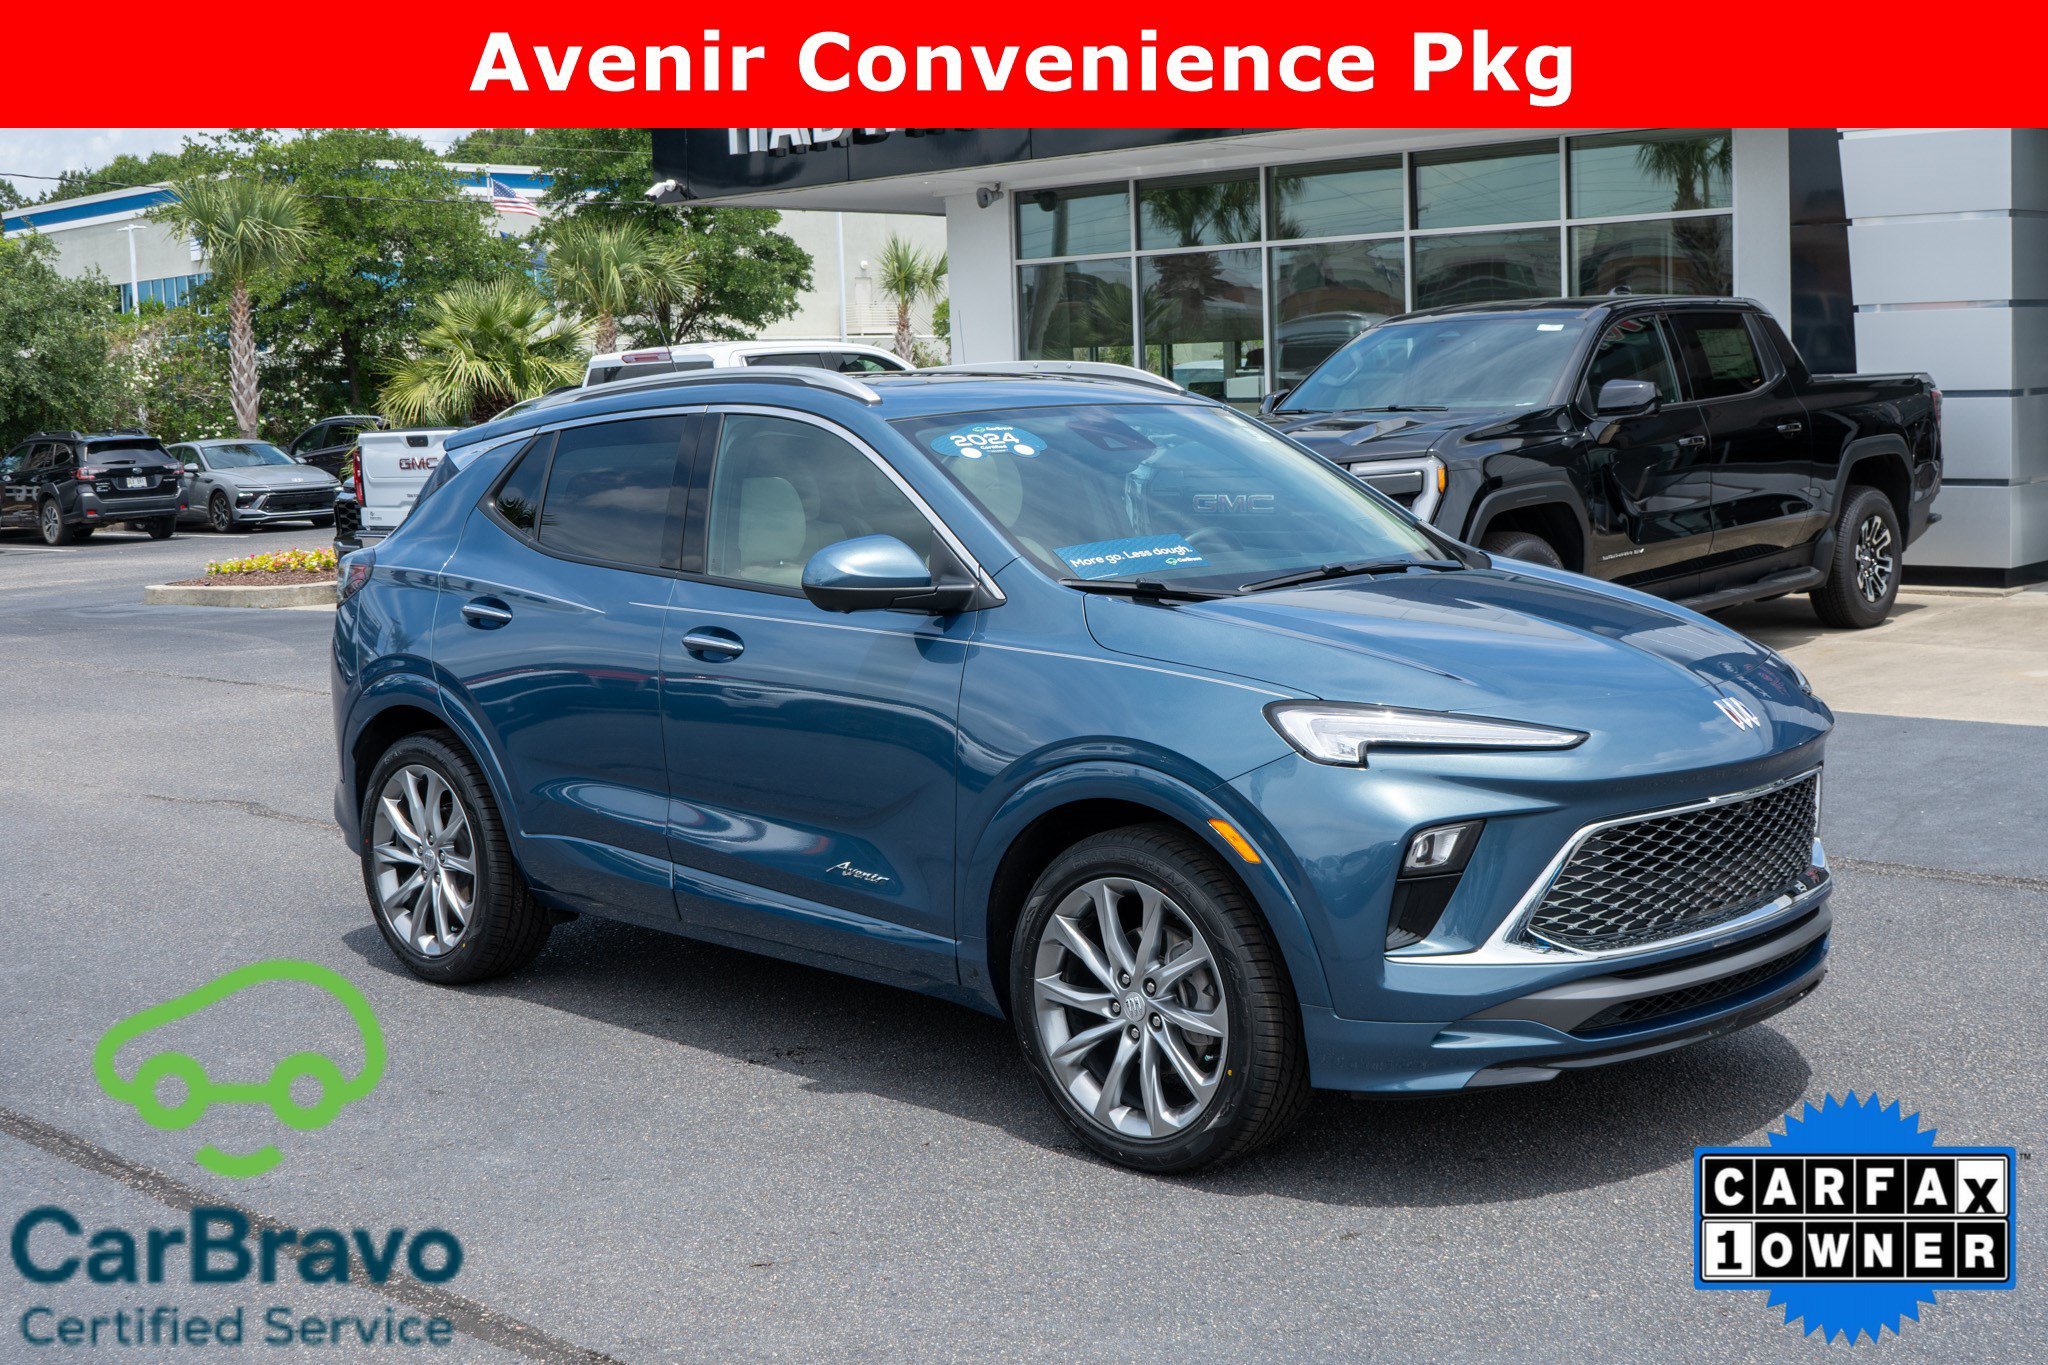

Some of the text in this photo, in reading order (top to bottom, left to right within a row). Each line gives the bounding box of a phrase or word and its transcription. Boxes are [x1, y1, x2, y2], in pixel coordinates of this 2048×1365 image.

[950, 432, 1020, 447] 2024
[399, 457, 439, 470] GMC
[1193, 494, 1275, 513] GMC
[1070, 544, 1194, 568] More go. Less dough.
[825, 861, 891, 883] Avenir
